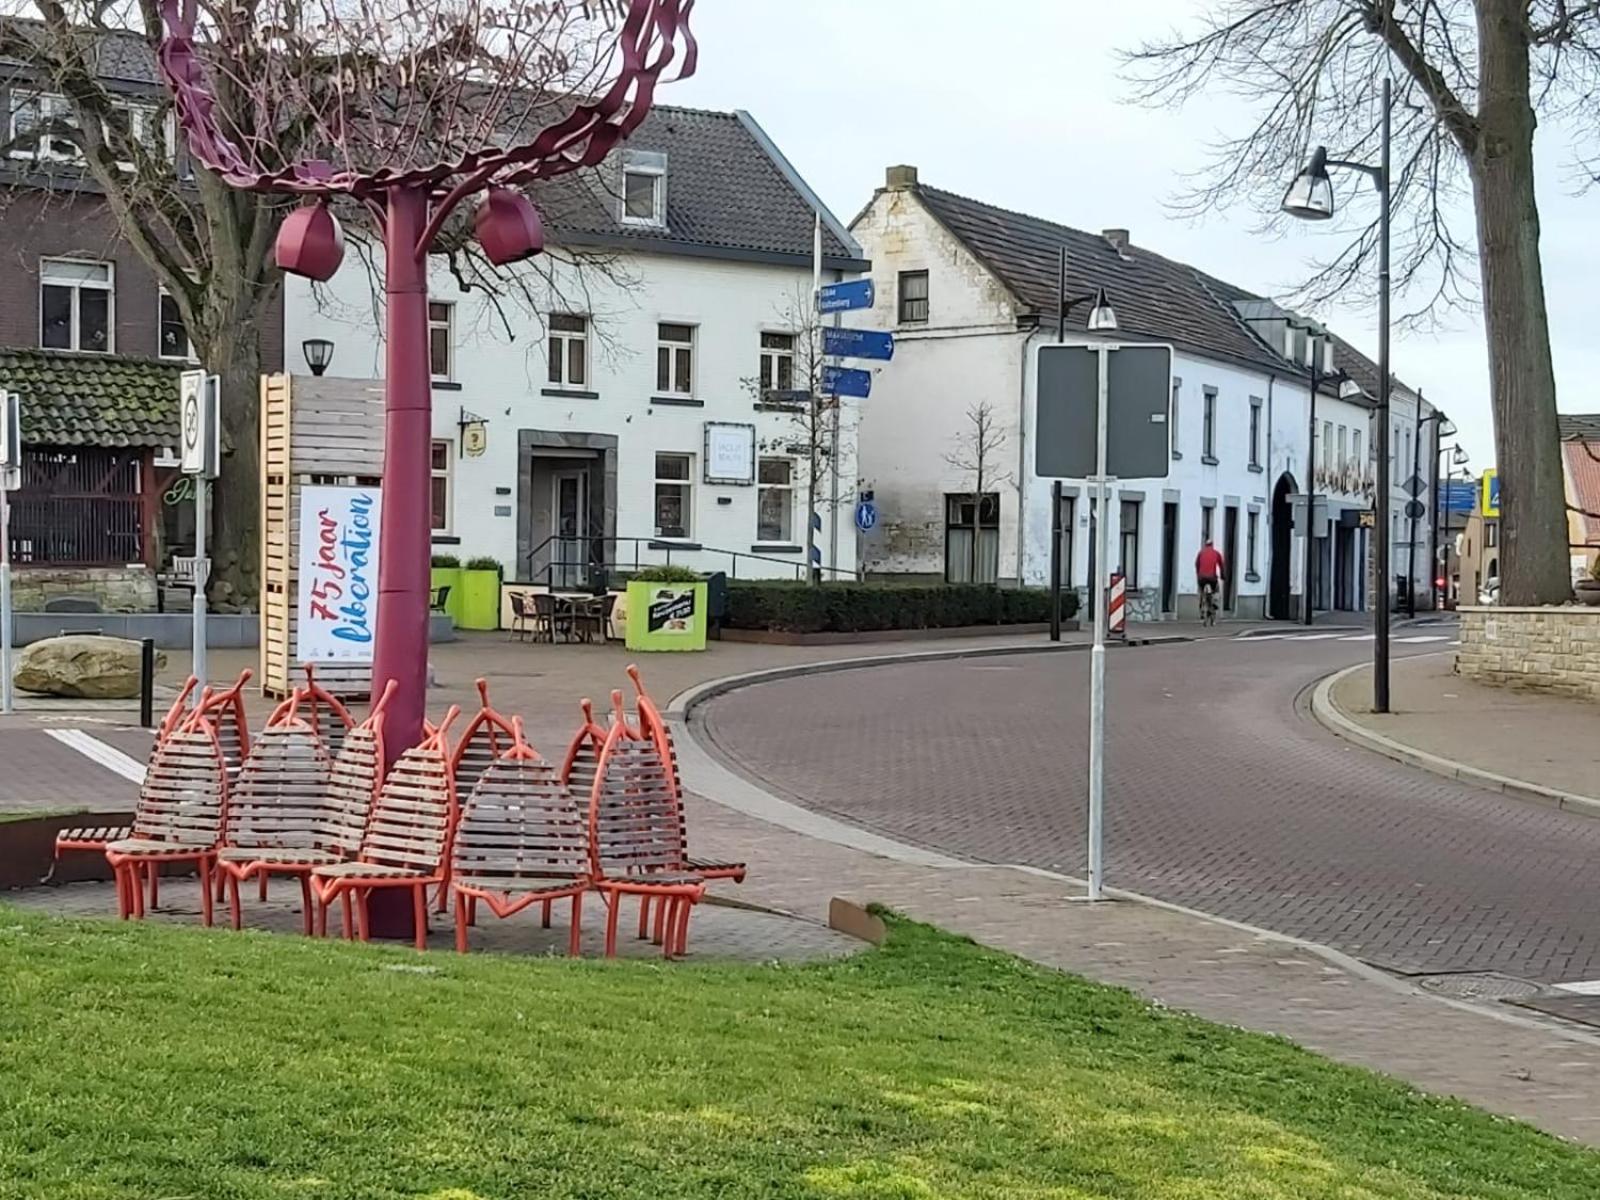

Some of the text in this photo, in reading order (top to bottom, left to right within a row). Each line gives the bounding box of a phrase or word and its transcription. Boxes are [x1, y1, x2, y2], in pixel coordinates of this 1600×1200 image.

[312, 508, 346, 579] jaar
[332, 493, 374, 643] liberation
[310, 578, 343, 621] 75
